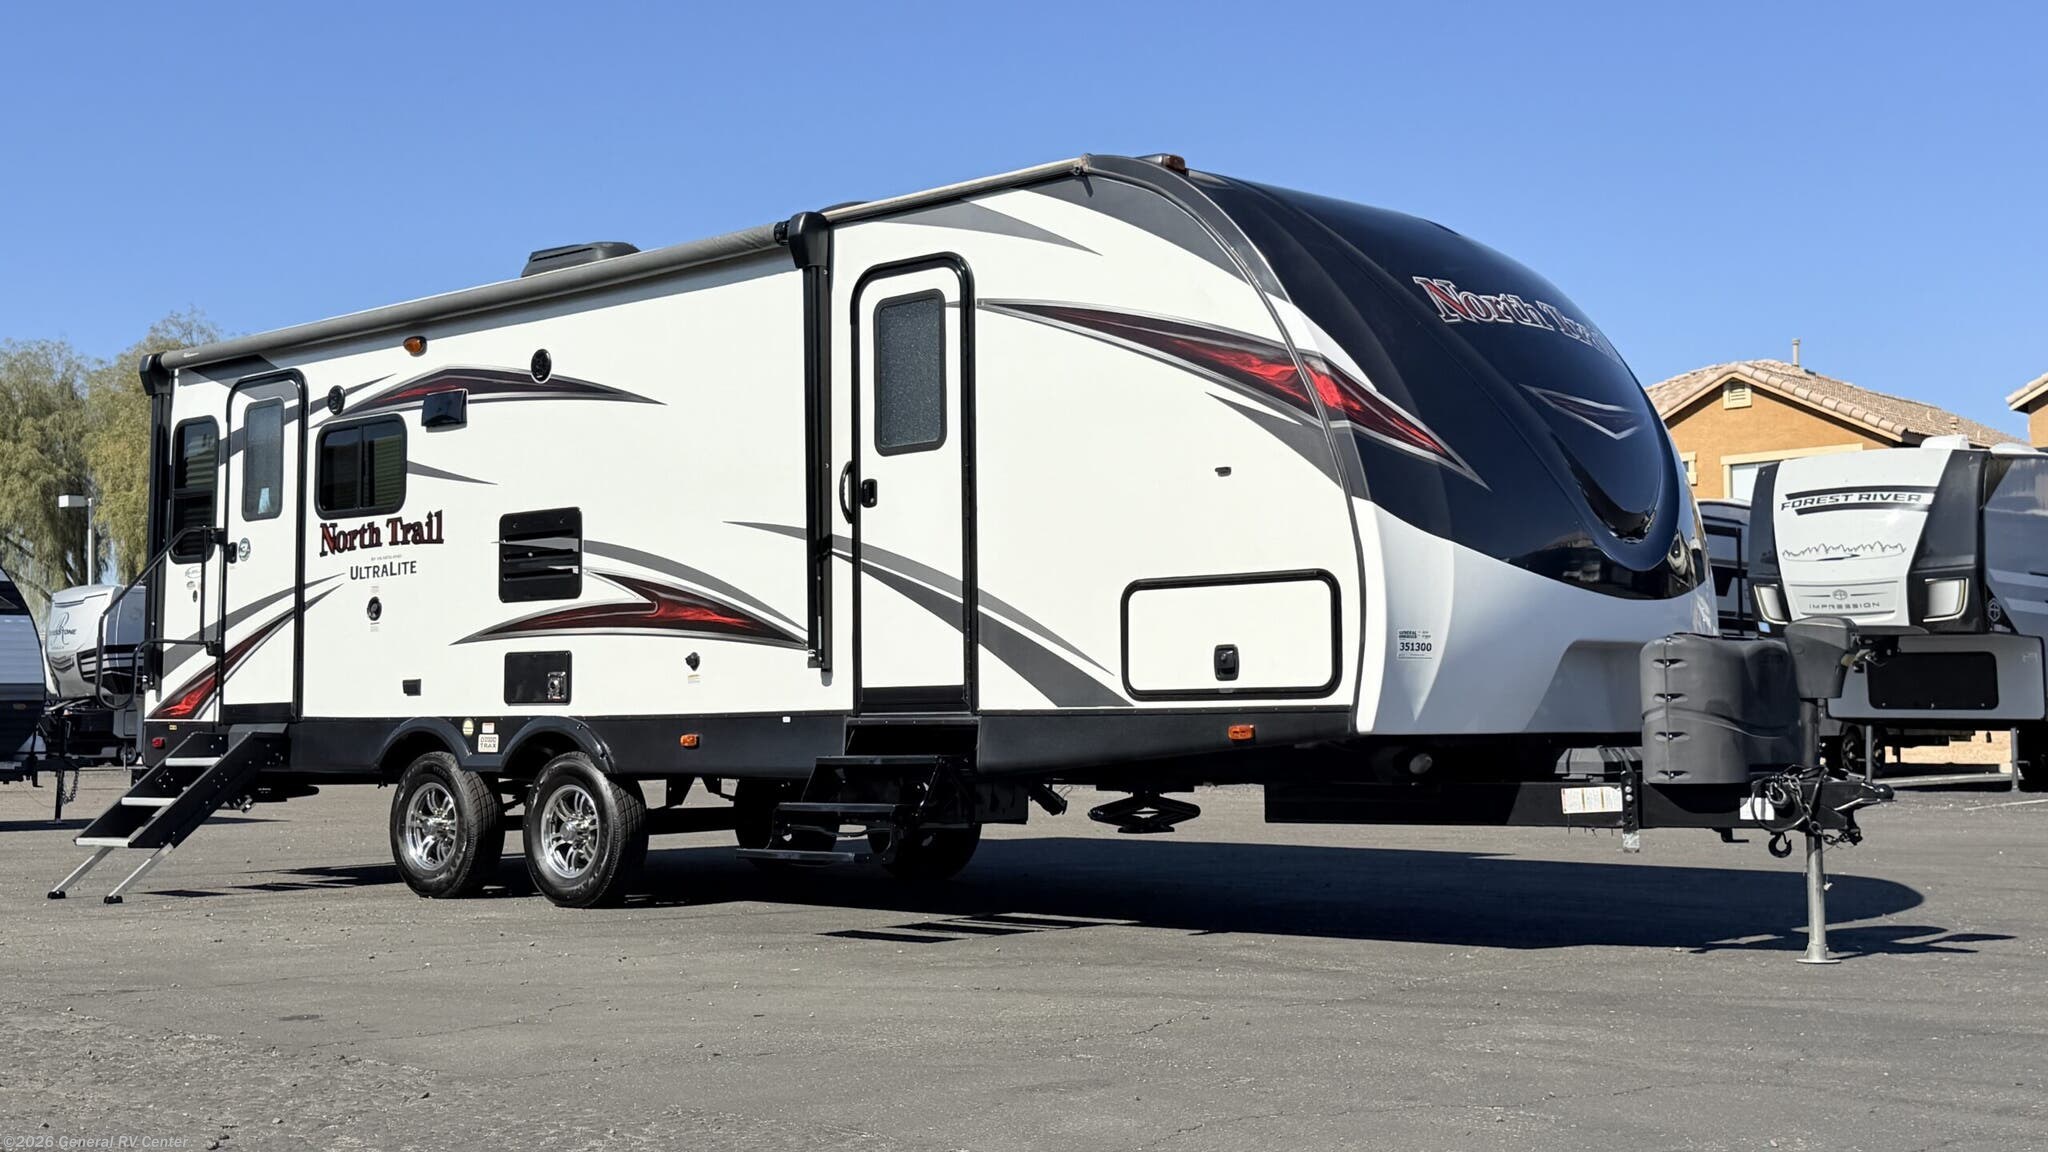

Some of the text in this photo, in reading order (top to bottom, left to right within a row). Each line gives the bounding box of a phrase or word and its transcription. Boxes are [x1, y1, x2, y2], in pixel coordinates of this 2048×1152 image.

[1412, 276, 1555, 331] North
[1781, 493, 1922, 511] FOREST RIVER
[319, 509, 445, 558] North Trail
[350, 560, 417, 580] ULTRALITE
[1400, 642, 1432, 652] 351300
